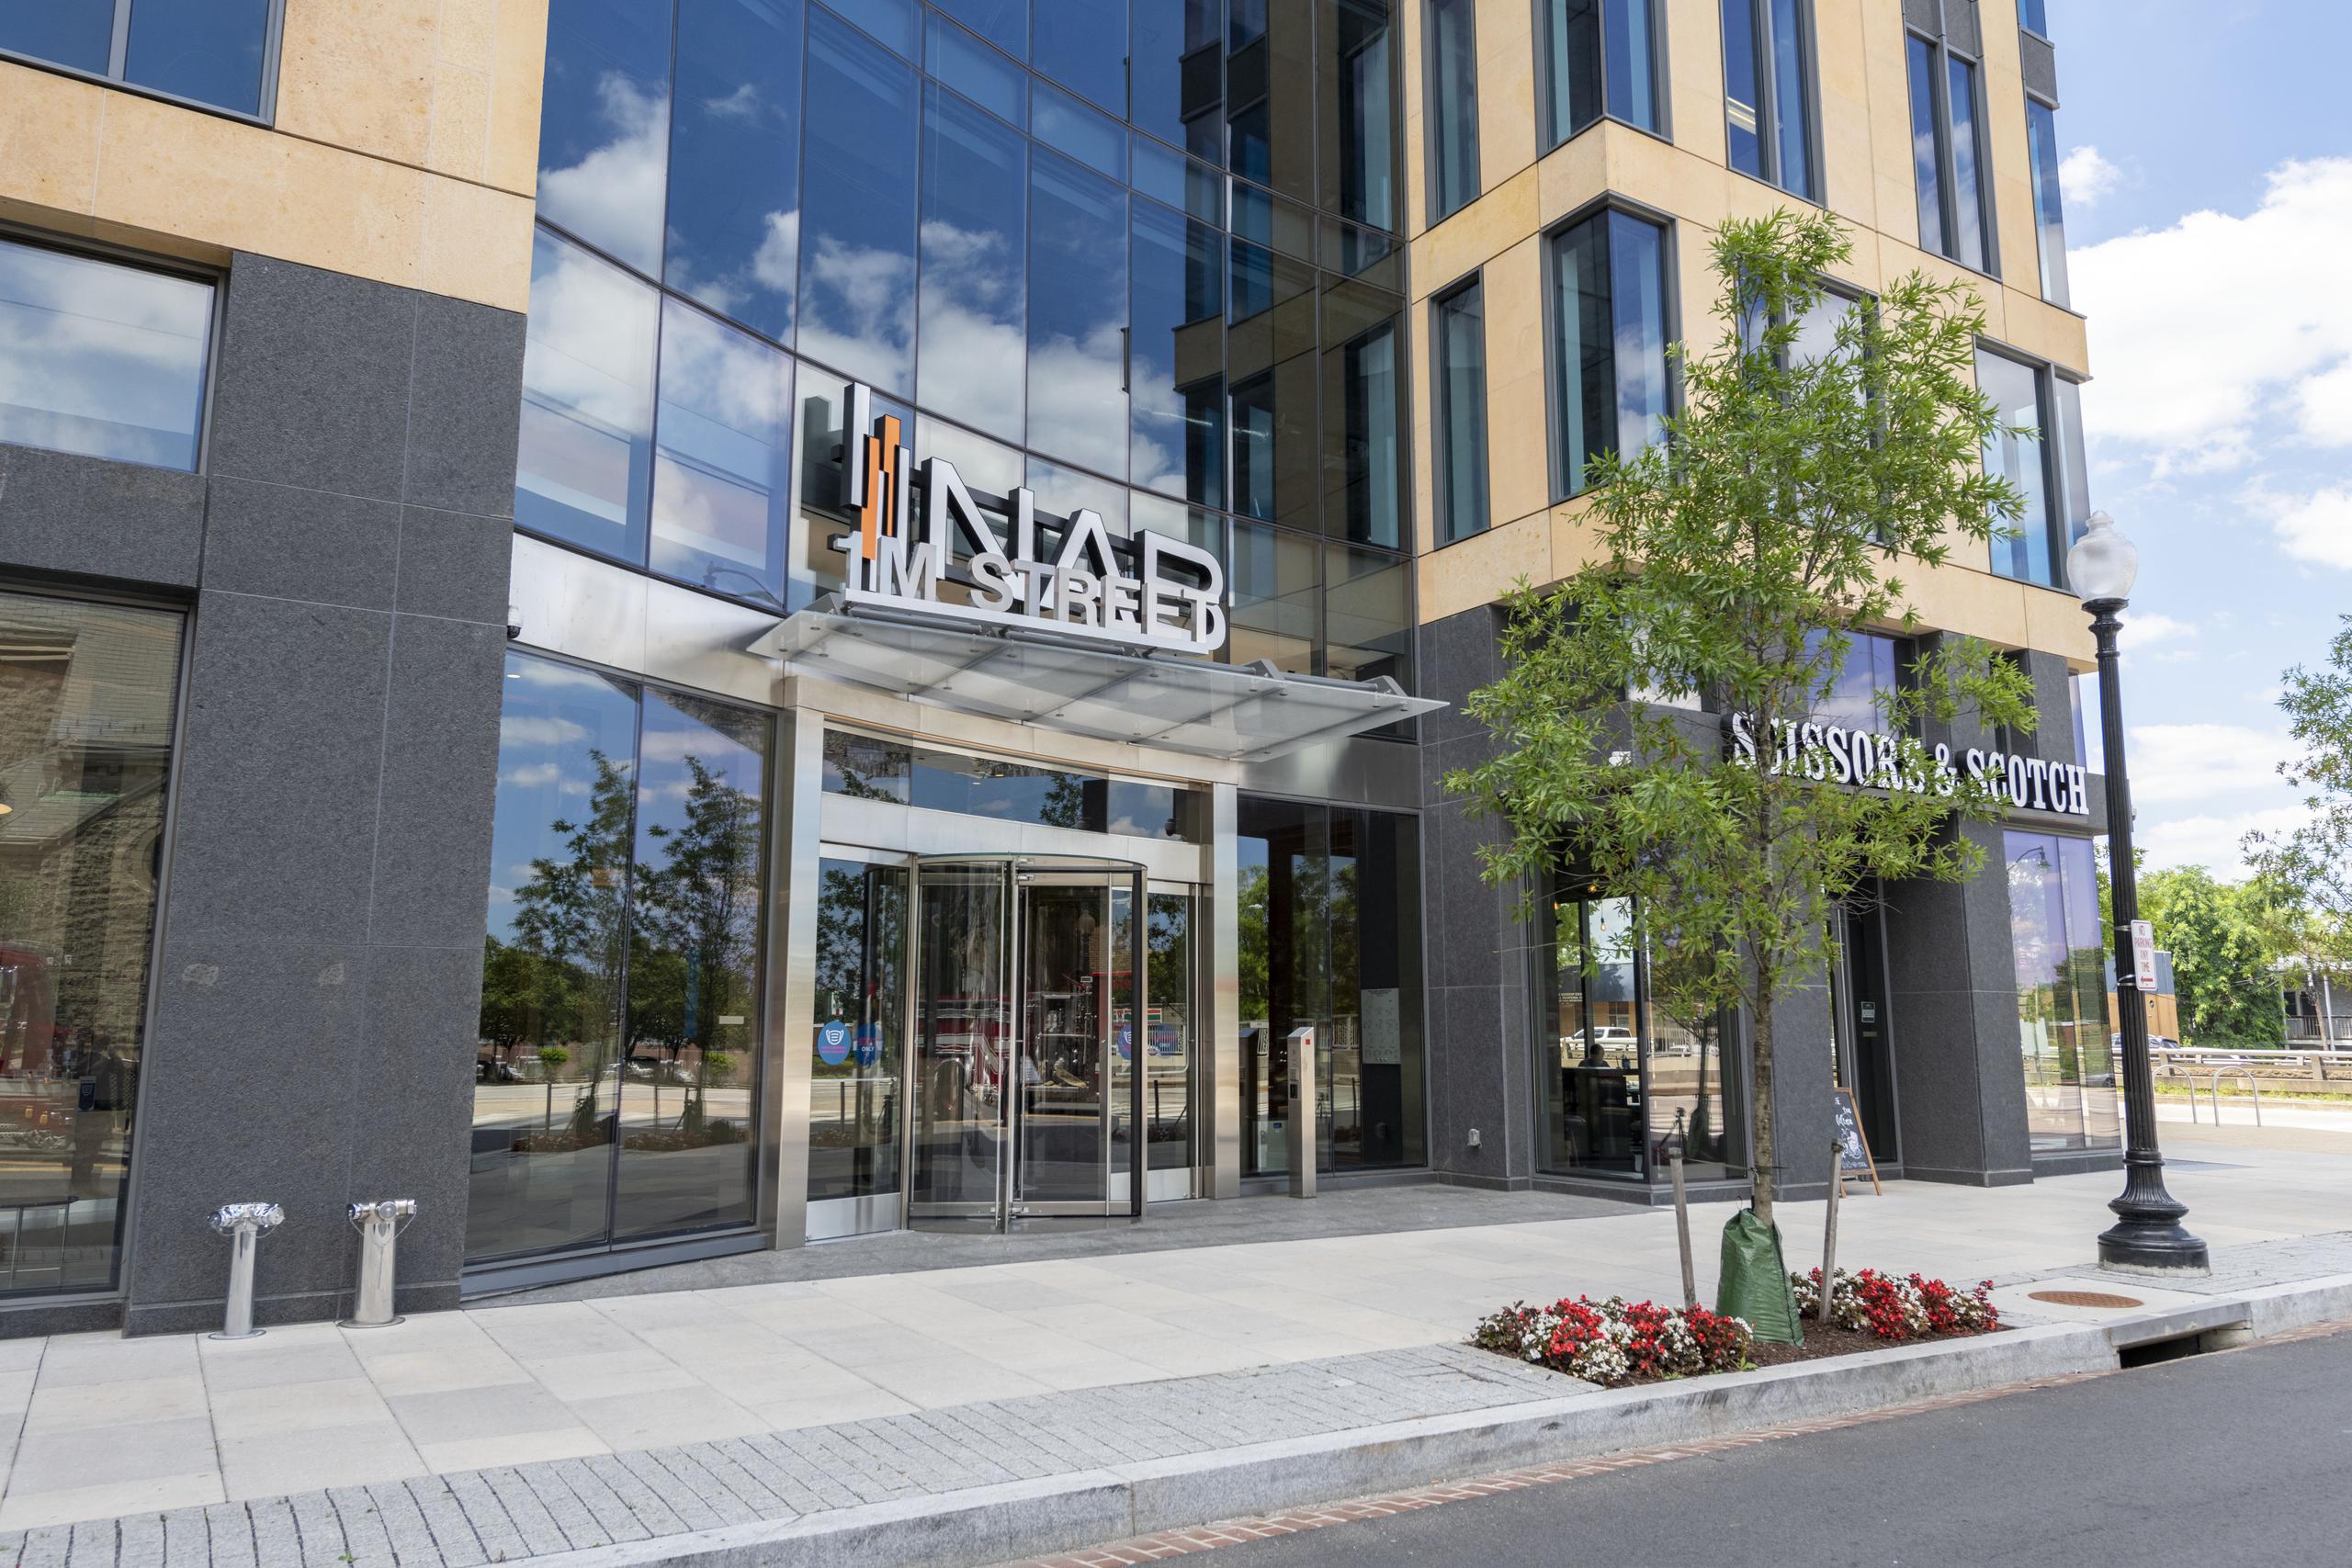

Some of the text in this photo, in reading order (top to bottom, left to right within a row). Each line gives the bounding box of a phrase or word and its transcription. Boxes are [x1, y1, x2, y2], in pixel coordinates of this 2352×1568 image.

[921, 457, 1226, 650] NAB
[876, 536, 937, 601] M
[967, 551, 1220, 644] STREET
[1934, 742, 1961, 797] &
[1966, 747, 2090, 816] SCOTCH
[2134, 937, 2152, 949] PARKING
[2138, 925, 2146, 936] NO
[2141, 962, 2150, 973] TIME
